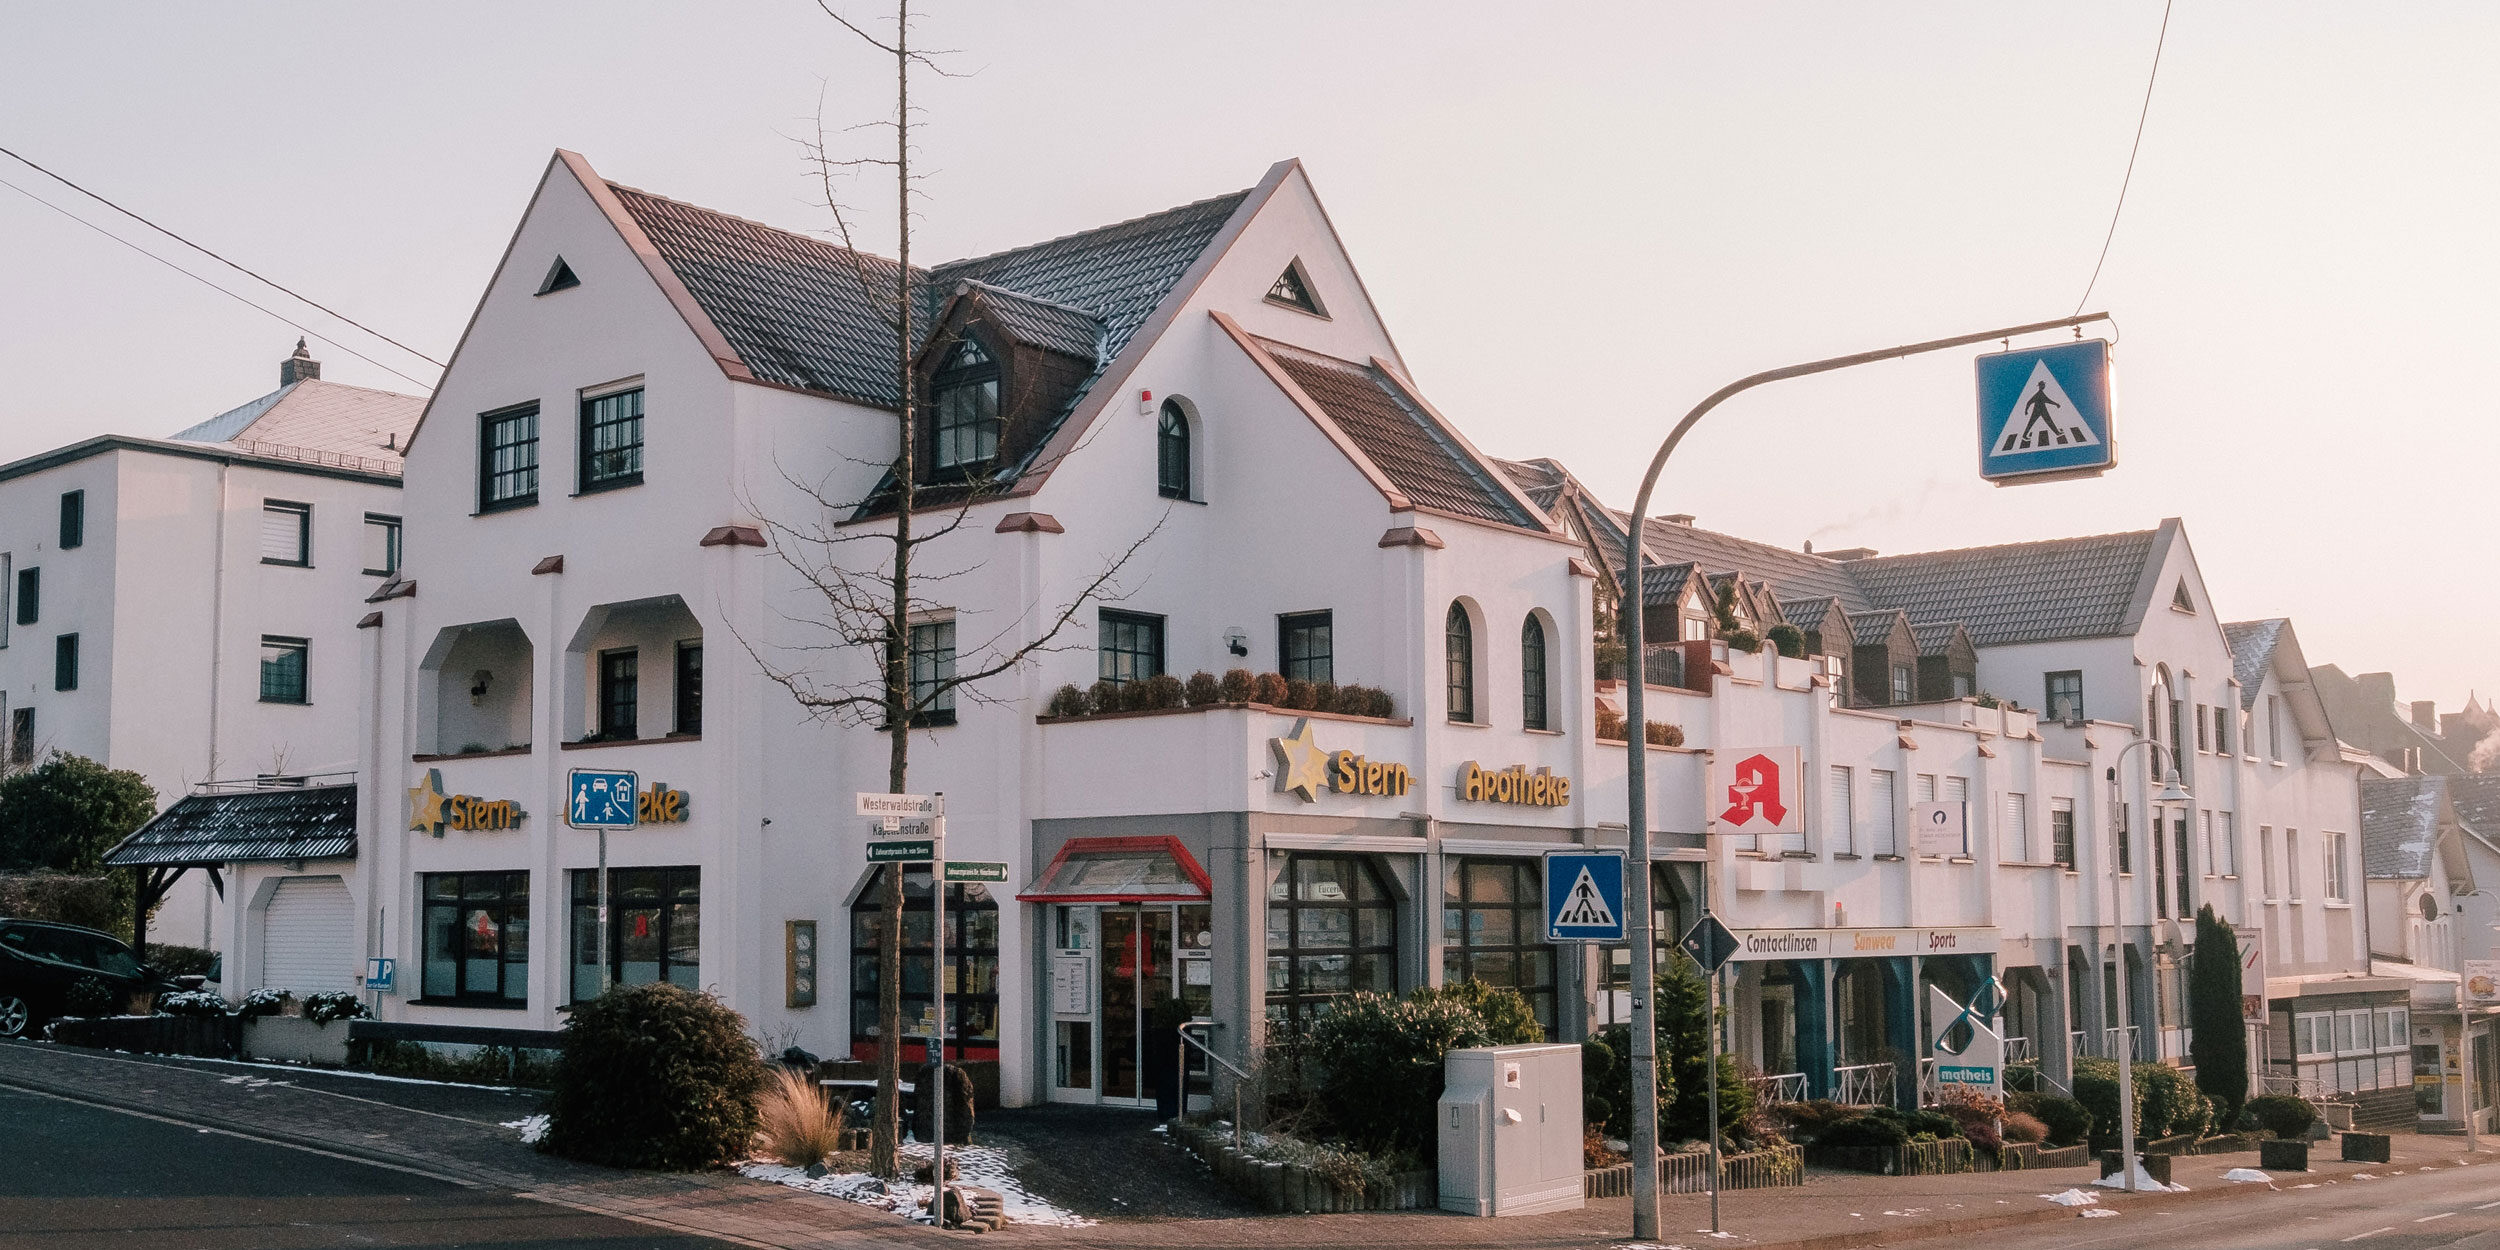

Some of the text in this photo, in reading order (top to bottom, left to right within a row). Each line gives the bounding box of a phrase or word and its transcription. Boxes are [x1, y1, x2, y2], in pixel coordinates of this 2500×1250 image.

[1338, 750, 1570, 806] Stern- Apotheke
[451, 794, 518, 830] Stern-
[863, 797, 933, 812] Westerwaldstraße
[1747, 931, 1956, 953] Contactlinsen Sunwear Sports
[383, 960, 392, 979] P
[1941, 1069, 1991, 1081] matheis
